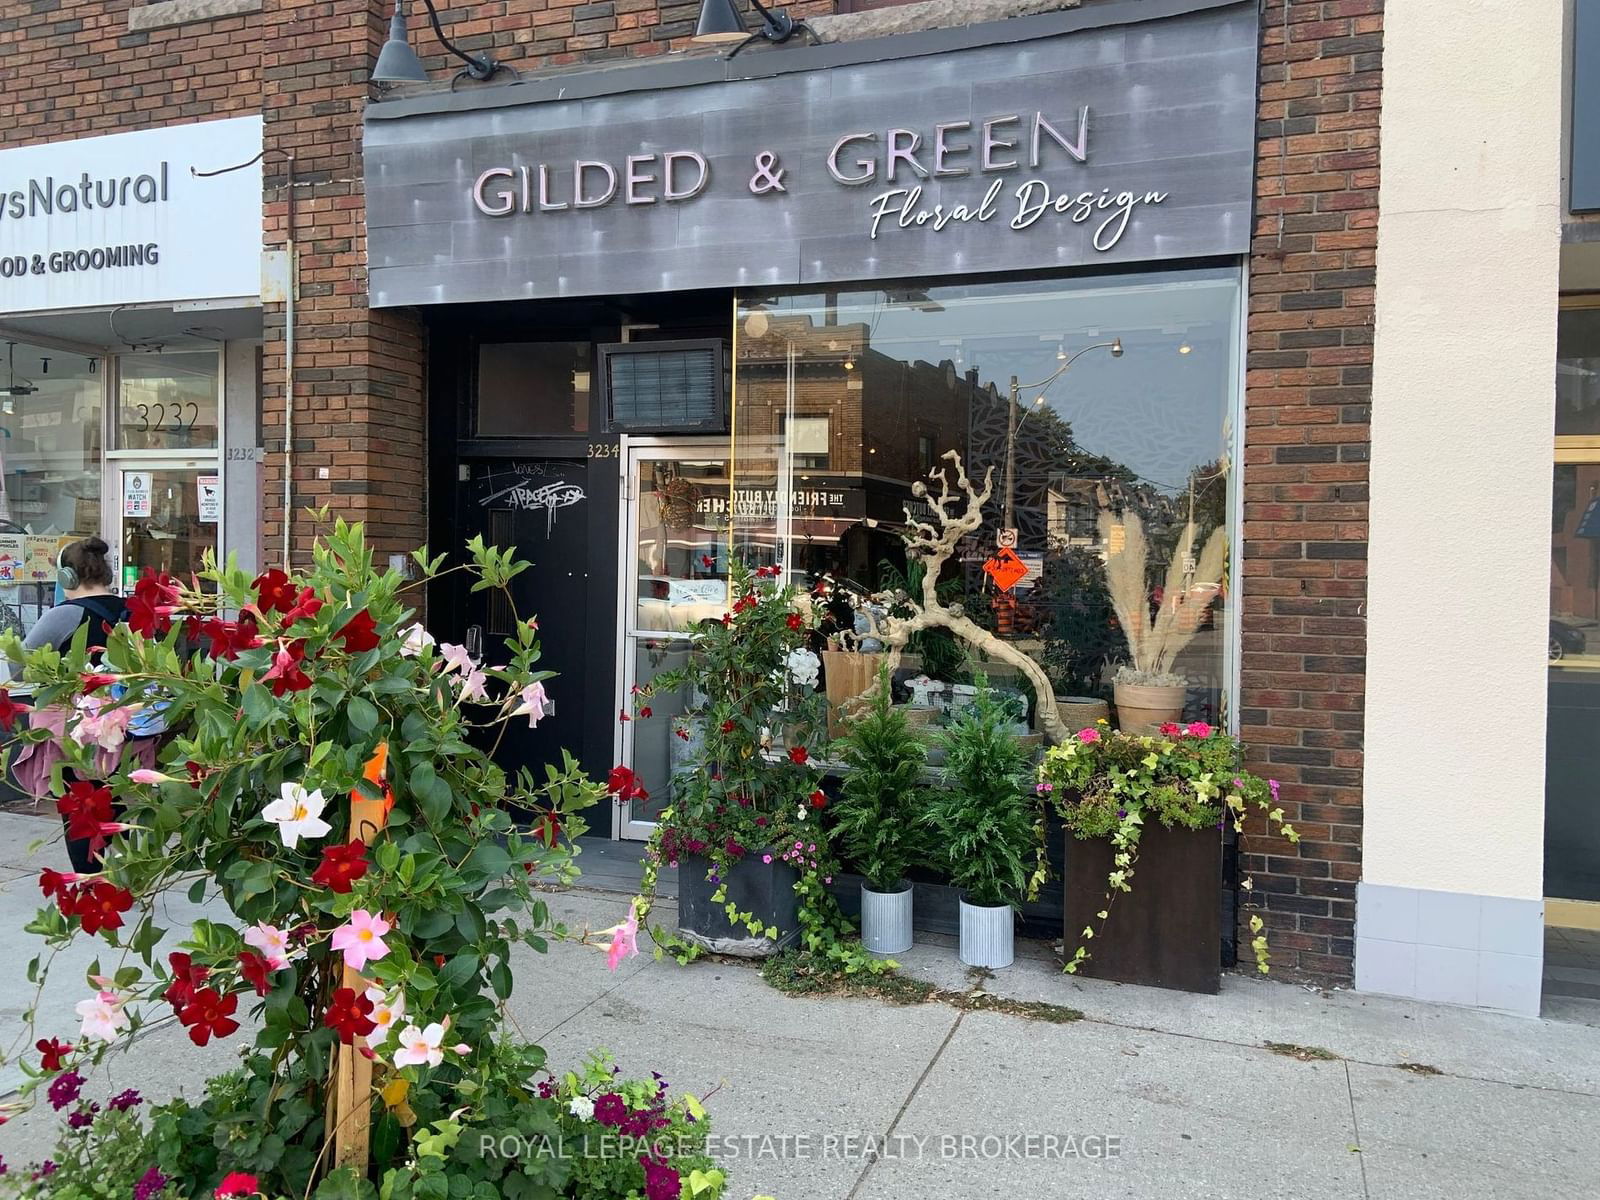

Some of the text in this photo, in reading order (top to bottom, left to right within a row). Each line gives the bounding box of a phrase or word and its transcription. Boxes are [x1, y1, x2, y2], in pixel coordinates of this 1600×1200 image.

[473, 105, 1091, 217] GILDED & GREEN
[869, 178, 1169, 252] Floral Design
[30, 253, 46, 275] &
[49, 242, 159, 273] GROOMING
[136, 402, 201, 432] 3232
[227, 447, 254, 461] 3232
[587, 443, 620, 459] 3234
